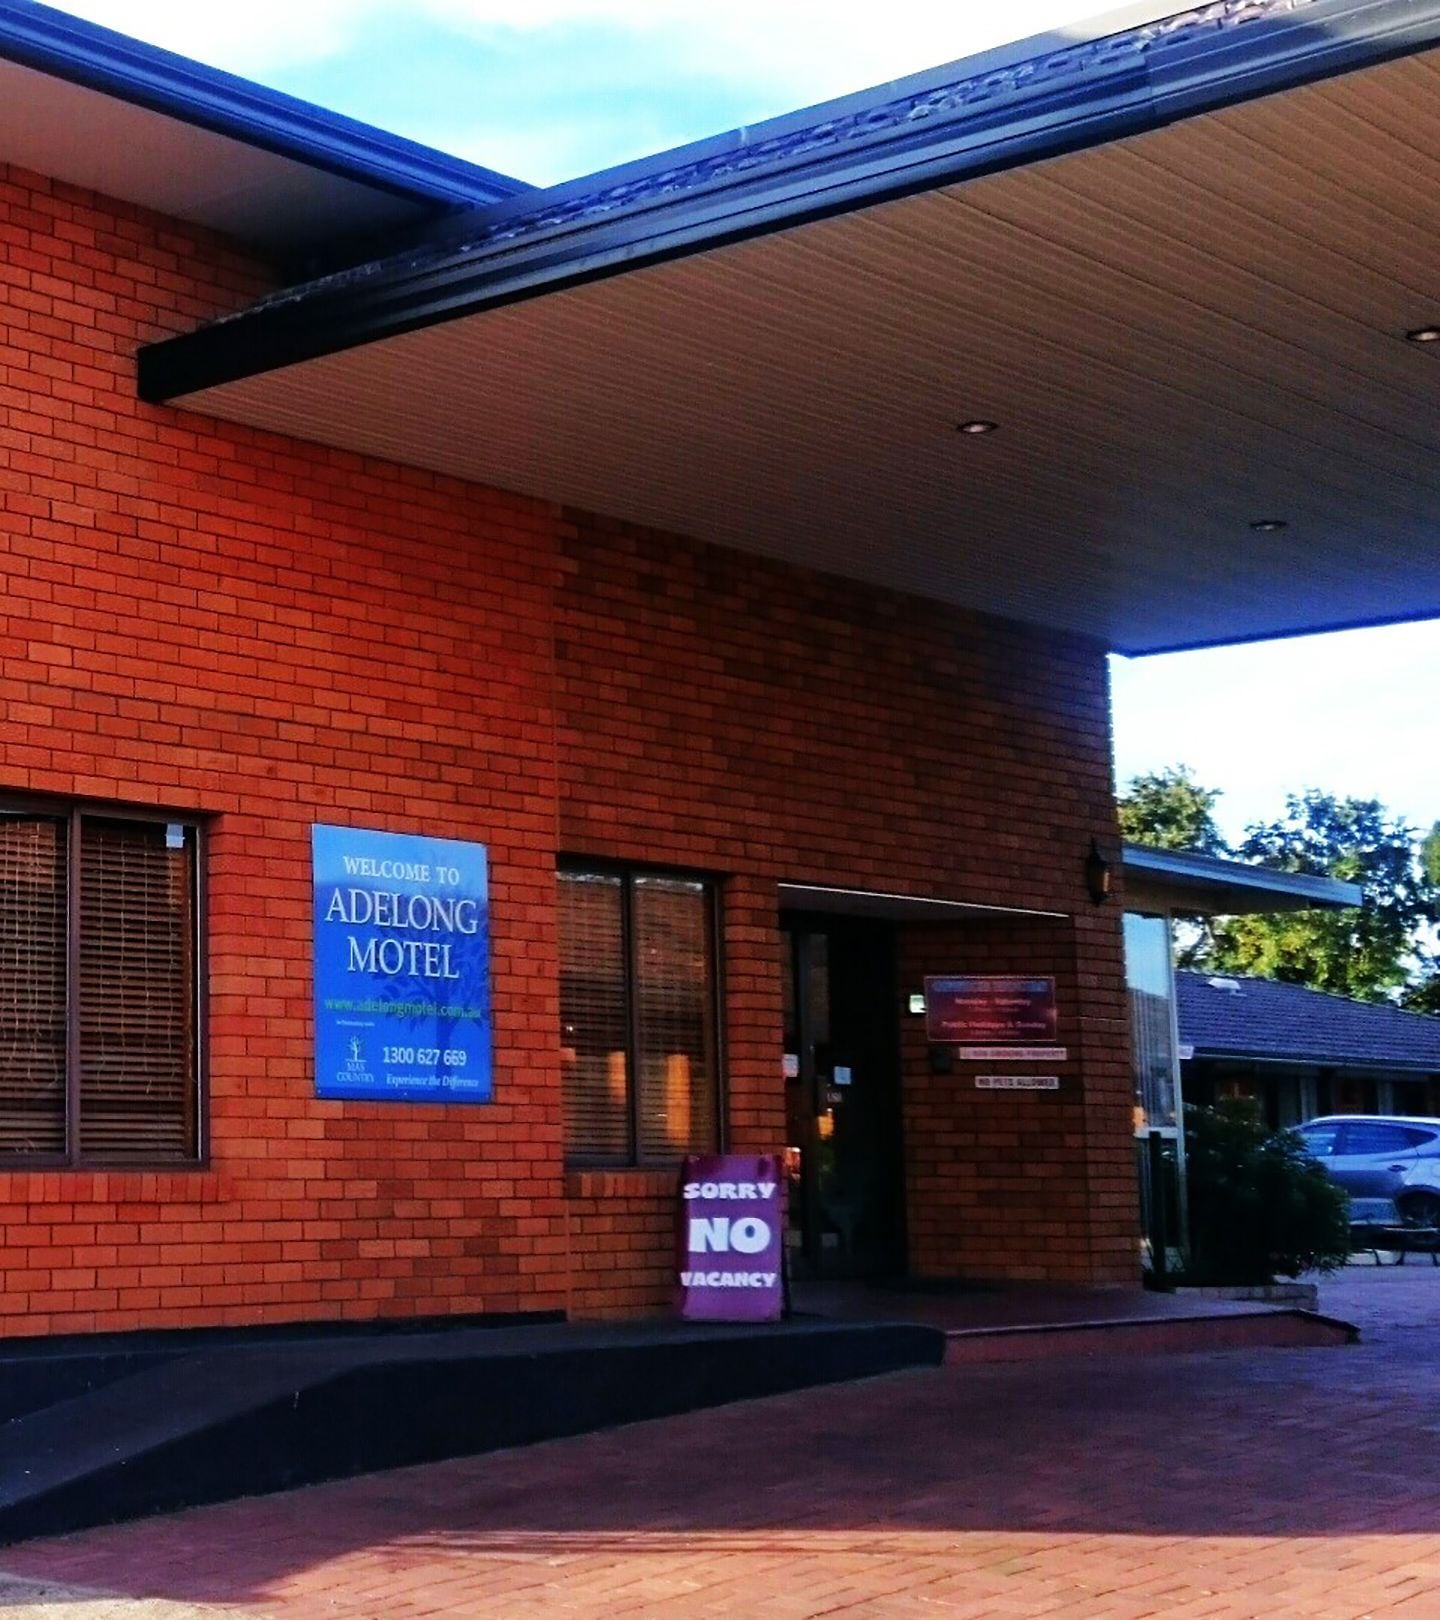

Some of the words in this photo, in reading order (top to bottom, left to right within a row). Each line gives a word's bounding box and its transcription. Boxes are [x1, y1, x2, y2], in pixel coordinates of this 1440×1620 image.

[342, 855, 430, 883] WELCOME
[436, 866, 460, 885] TO
[325, 887, 478, 935] ADELONG
[346, 936, 460, 979] MOTEL
[383, 1046, 415, 1065] 1300
[417, 1049, 440, 1066] 627
[443, 1050, 467, 1067] 669
[386, 1074, 428, 1089] Experience
[428, 1075, 441, 1086] the
[442, 1077, 479, 1089] Difference
[683, 1182, 777, 1200] SORRY
[688, 1217, 772, 1254] NO
[680, 1271, 778, 1288] VACANCY
